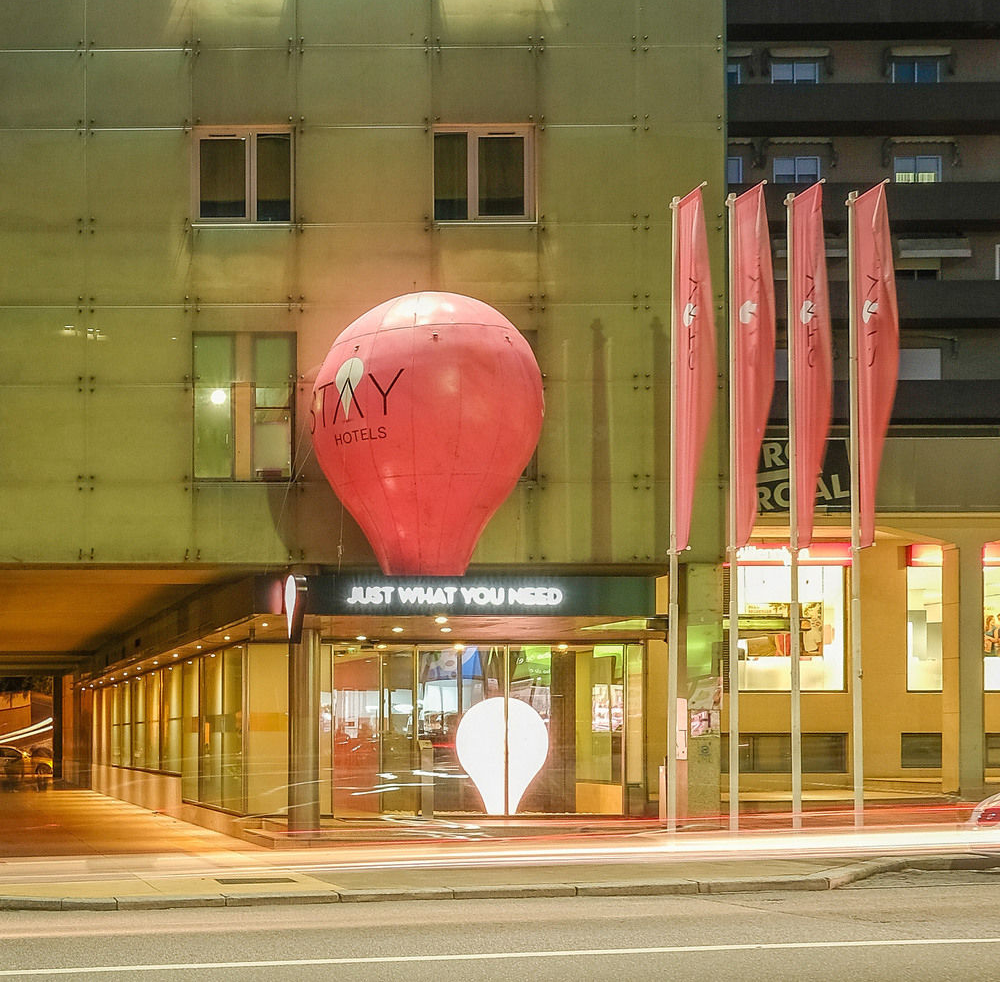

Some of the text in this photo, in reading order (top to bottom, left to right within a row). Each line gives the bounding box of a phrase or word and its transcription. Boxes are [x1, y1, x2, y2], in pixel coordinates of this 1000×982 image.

[334, 426, 388, 446] HOTELS
[756, 474, 850, 511] ROAL
[347, 586, 564, 606] JUST WHAT YOU NEED
